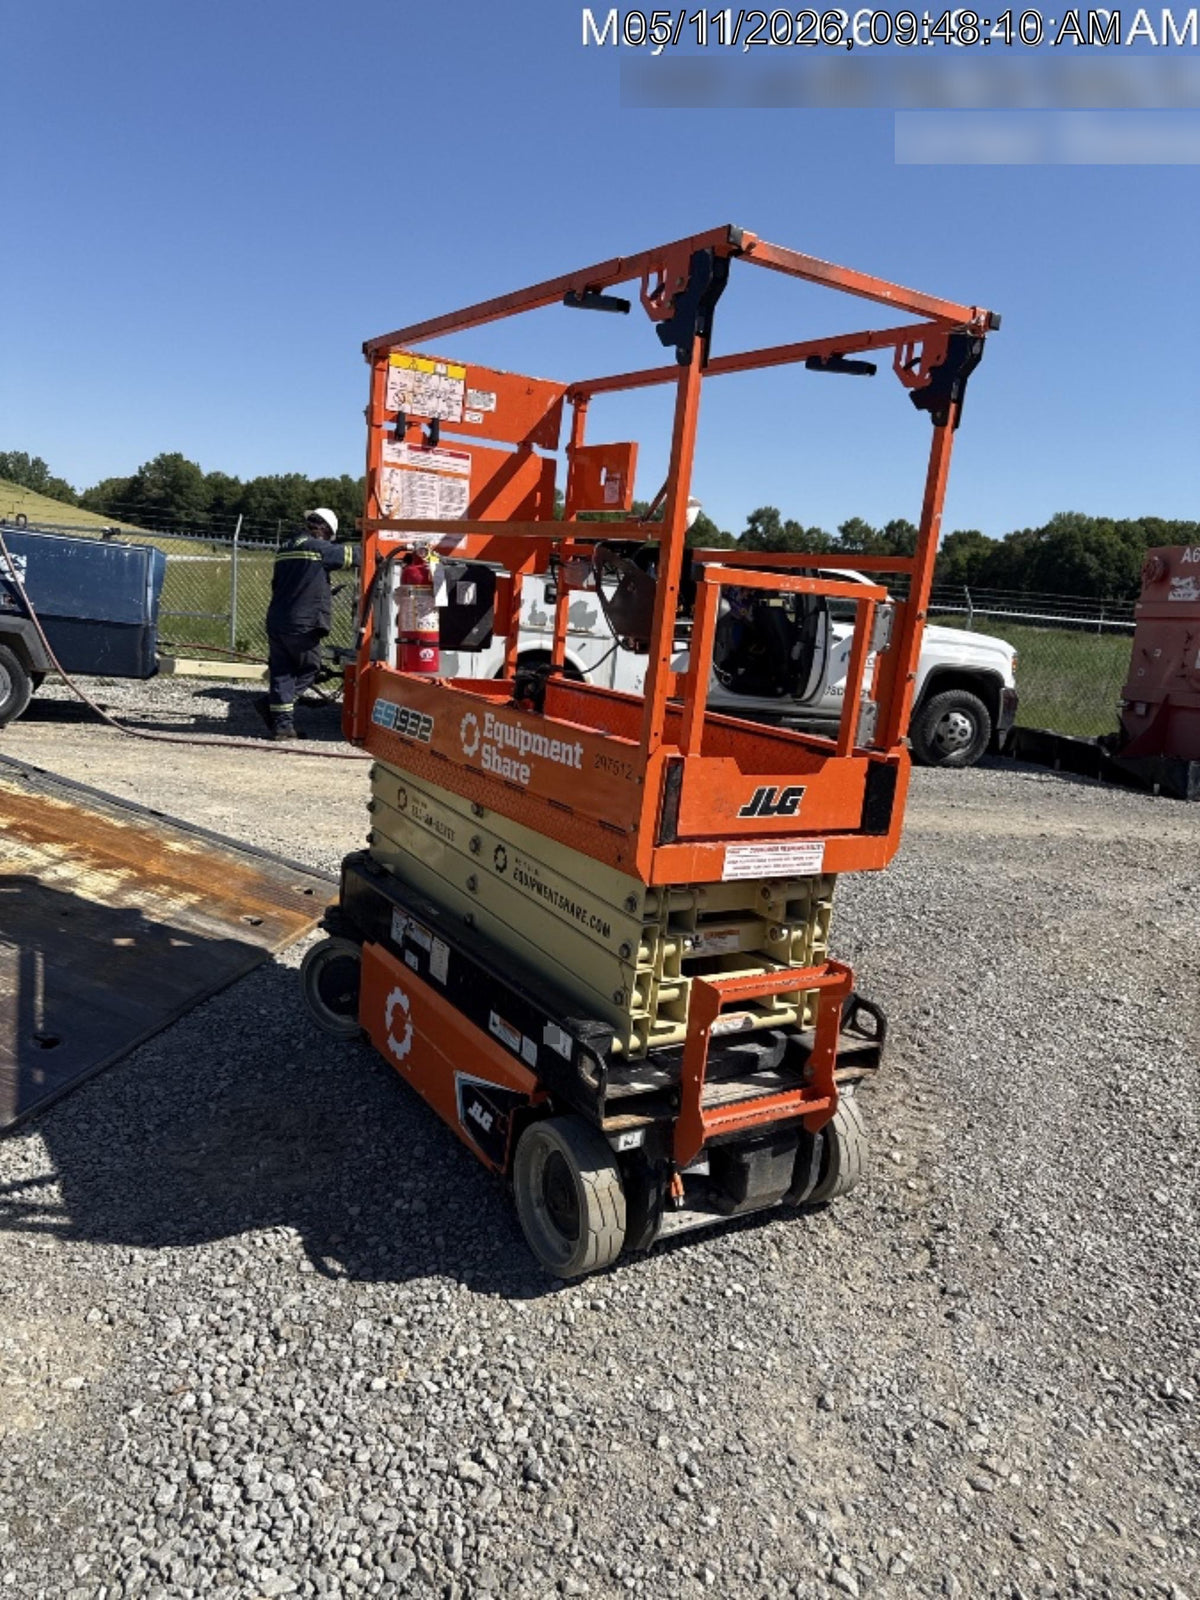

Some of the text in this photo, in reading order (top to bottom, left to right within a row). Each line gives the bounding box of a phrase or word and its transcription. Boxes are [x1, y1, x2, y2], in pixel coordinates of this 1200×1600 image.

[371, 698, 434, 743] ES1932
[483, 711, 584, 769] Equipment
[481, 743, 531, 785] Share
[736, 785, 808, 819] JLG
[467, 1100, 494, 1134] JLG
